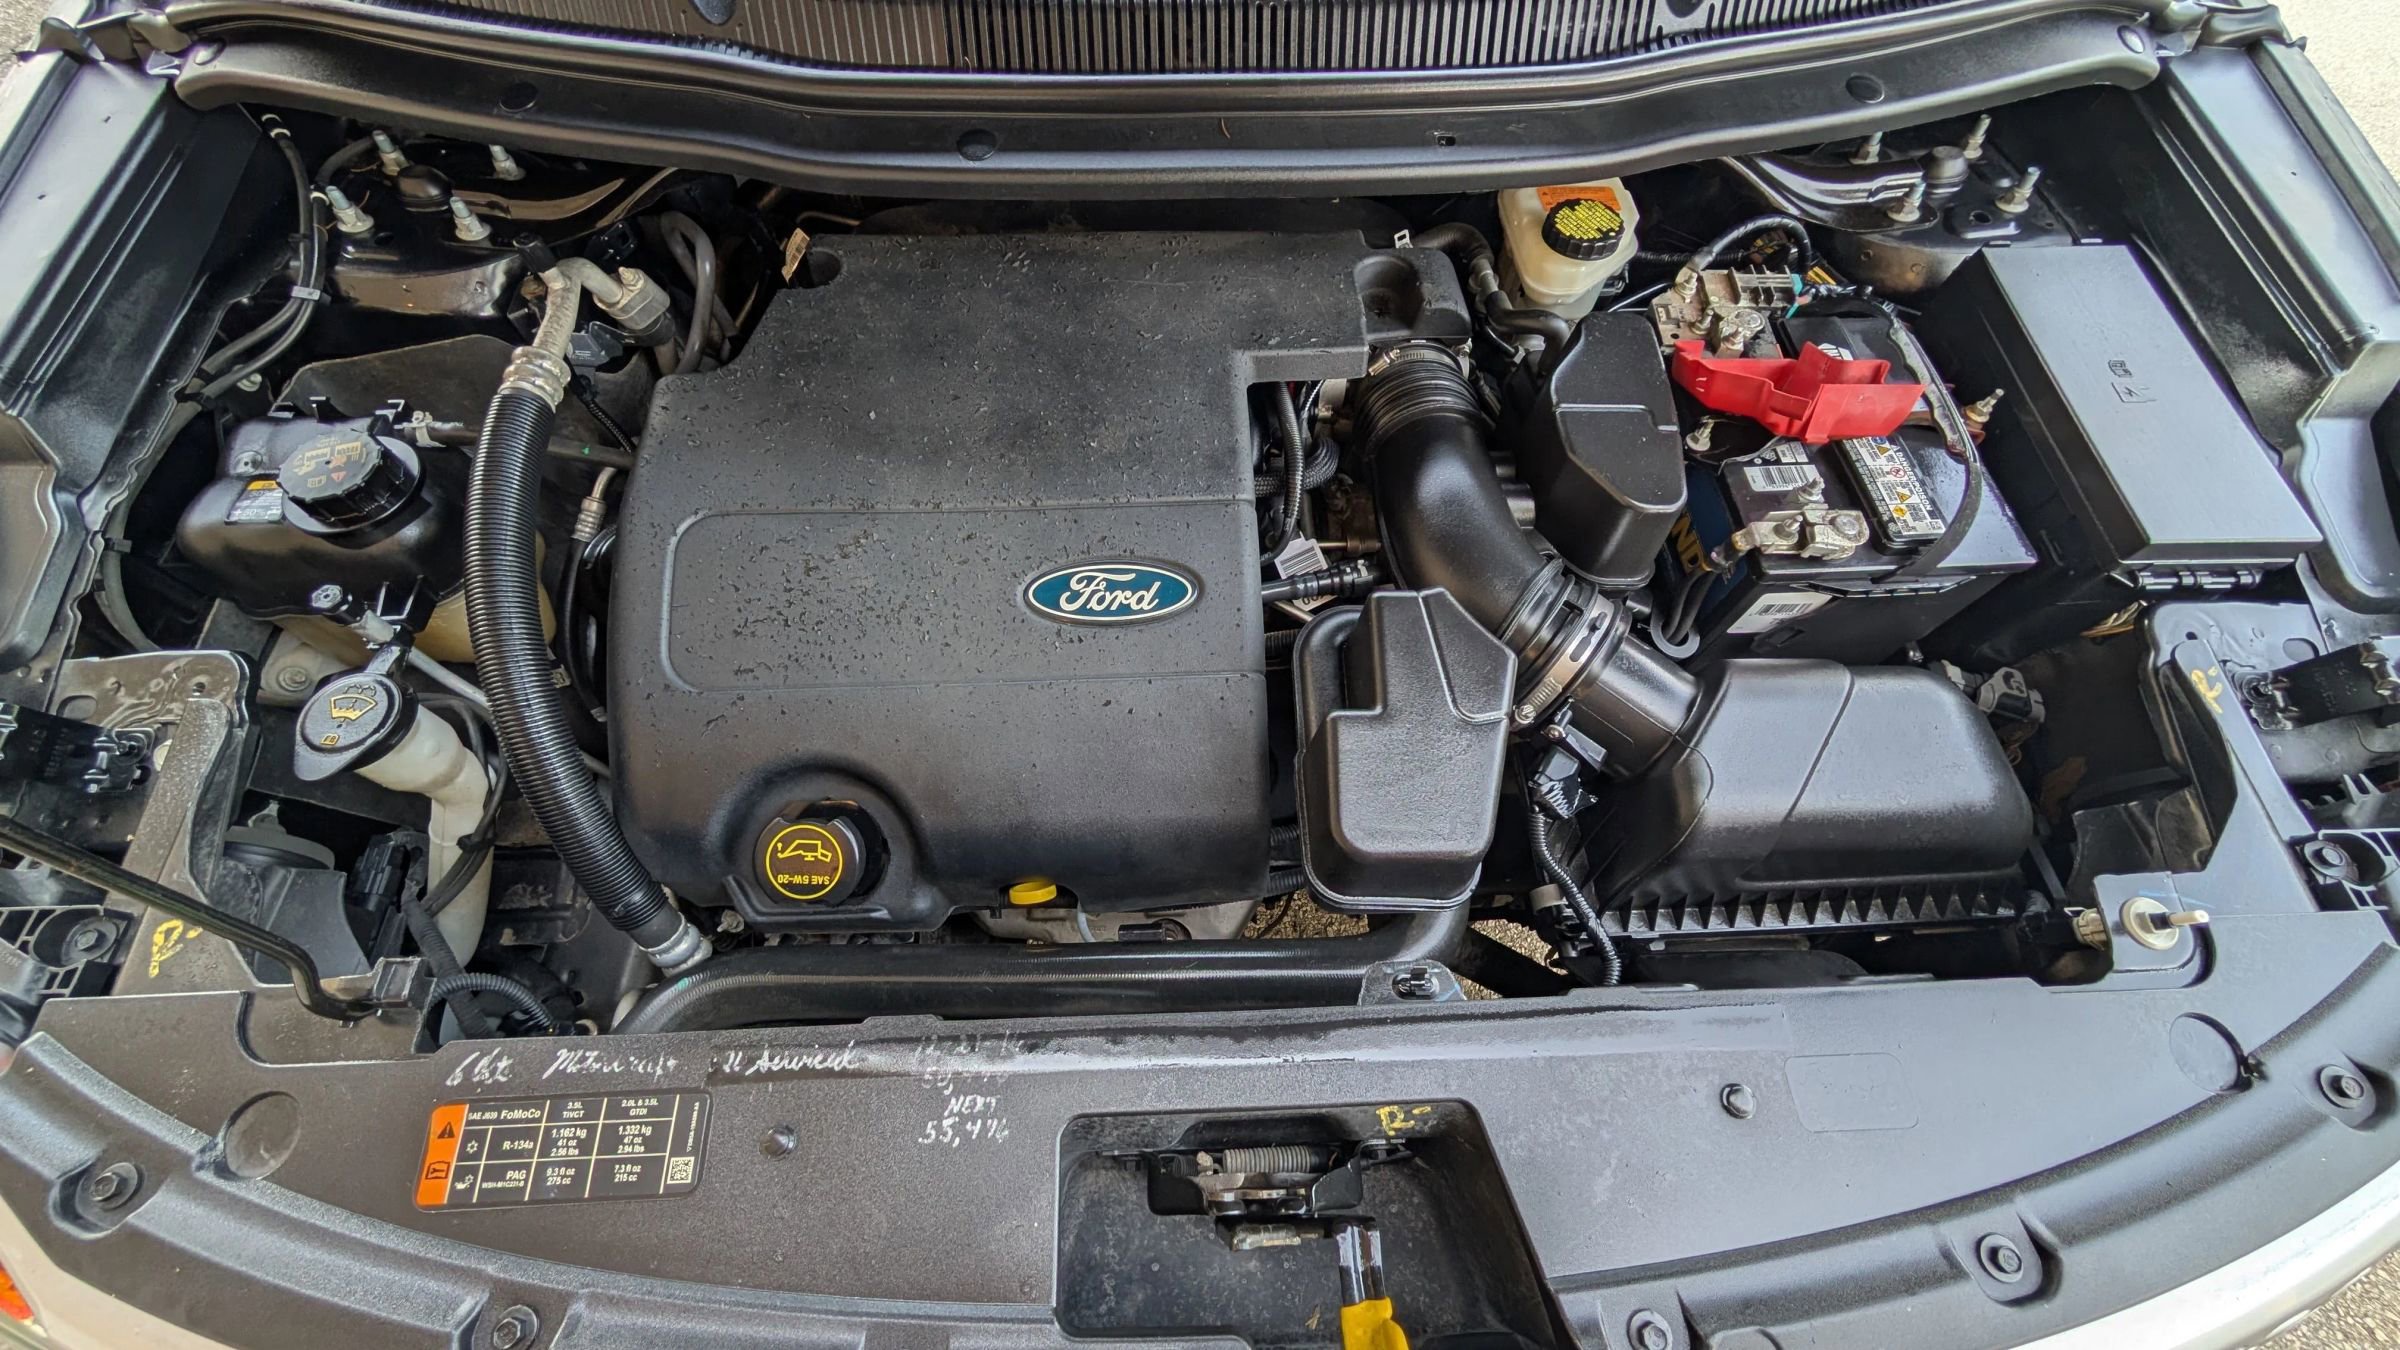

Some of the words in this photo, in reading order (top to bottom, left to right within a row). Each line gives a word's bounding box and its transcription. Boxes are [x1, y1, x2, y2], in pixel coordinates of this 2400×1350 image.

[1059, 571, 1162, 611] Ford
[777, 874, 809, 885] 5W-20
[811, 875, 830, 885] SAE
[944, 1094, 1000, 1117] NEXT
[468, 1112, 482, 1120] SAE
[500, 1108, 541, 1120] FoMoCo
[551, 1128, 575, 1138] 1.162
[575, 1127, 588, 1139] kg
[618, 1125, 640, 1136] 1.332
[640, 1124, 652, 1136] kg
[502, 1140, 534, 1150] R-134a
[557, 1139, 567, 1147] 41
[623, 1136, 633, 1144] 47
[633, 1136, 643, 1144] oz
[617, 1145, 632, 1153] 2.94
[633, 1144, 645, 1153] lbs
[565, 1167, 576, 1175] oz
[614, 1165, 626, 1173] 7.3
[631, 1164, 642, 1173] oz
[506, 1170, 526, 1180] PAG
[614, 1173, 628, 1182] 215
[628, 1173, 638, 1182] cc
[546, 1176, 561, 1185] 275
[562, 1176, 572, 1184] cc
